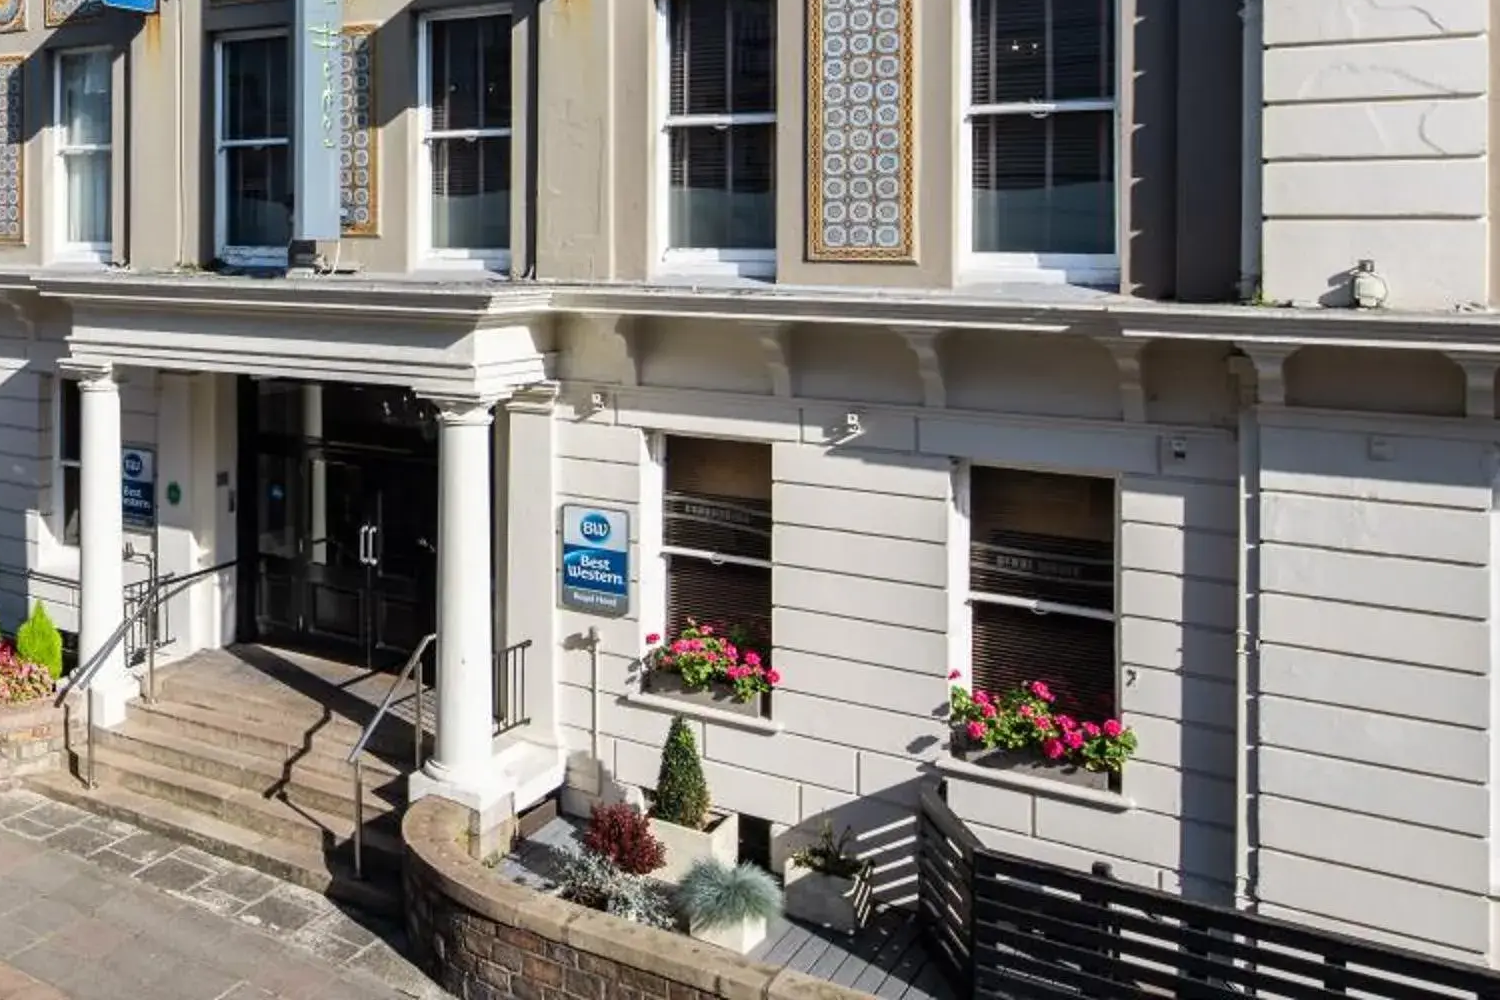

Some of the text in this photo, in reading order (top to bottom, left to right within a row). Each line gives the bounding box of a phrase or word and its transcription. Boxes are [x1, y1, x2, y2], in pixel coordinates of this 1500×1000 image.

[123, 497, 152, 511] estern
[583, 521, 608, 537] BW
[581, 554, 611, 571] Best
[567, 564, 624, 585] Western
